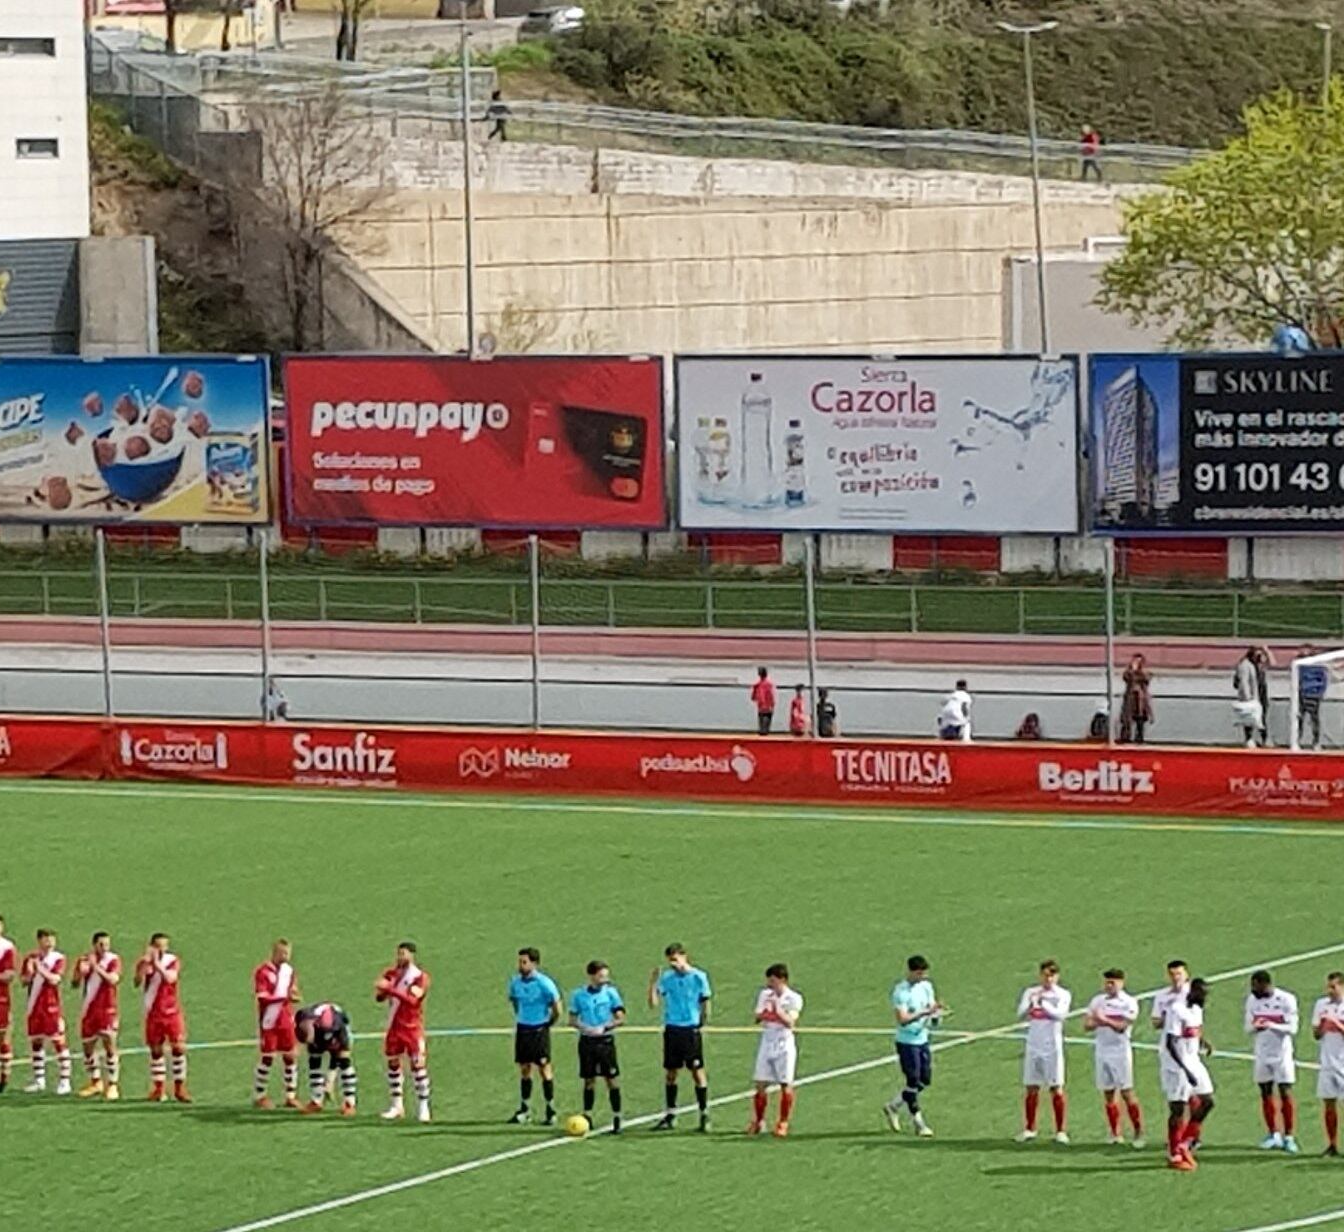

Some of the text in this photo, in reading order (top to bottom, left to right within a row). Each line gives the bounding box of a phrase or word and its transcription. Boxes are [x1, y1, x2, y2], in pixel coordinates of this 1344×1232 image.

[811, 380, 936, 413] Cazorla
[1223, 369, 1334, 393] SKYLINE
[311, 401, 484, 442] pecunpay
[1194, 409, 1234, 427] Vive
[1237, 412, 1262, 427] en
[1264, 409, 1284, 427] el
[1194, 462, 1227, 492] 91
[1233, 462, 1282, 492] 101
[1288, 462, 1330, 492] 43
[134, 738, 215, 762] Cazorla
[292, 732, 397, 774] Sanfiz
[831, 748, 953, 784] TECNITASA
[1038, 759, 1155, 794] Berlitz
